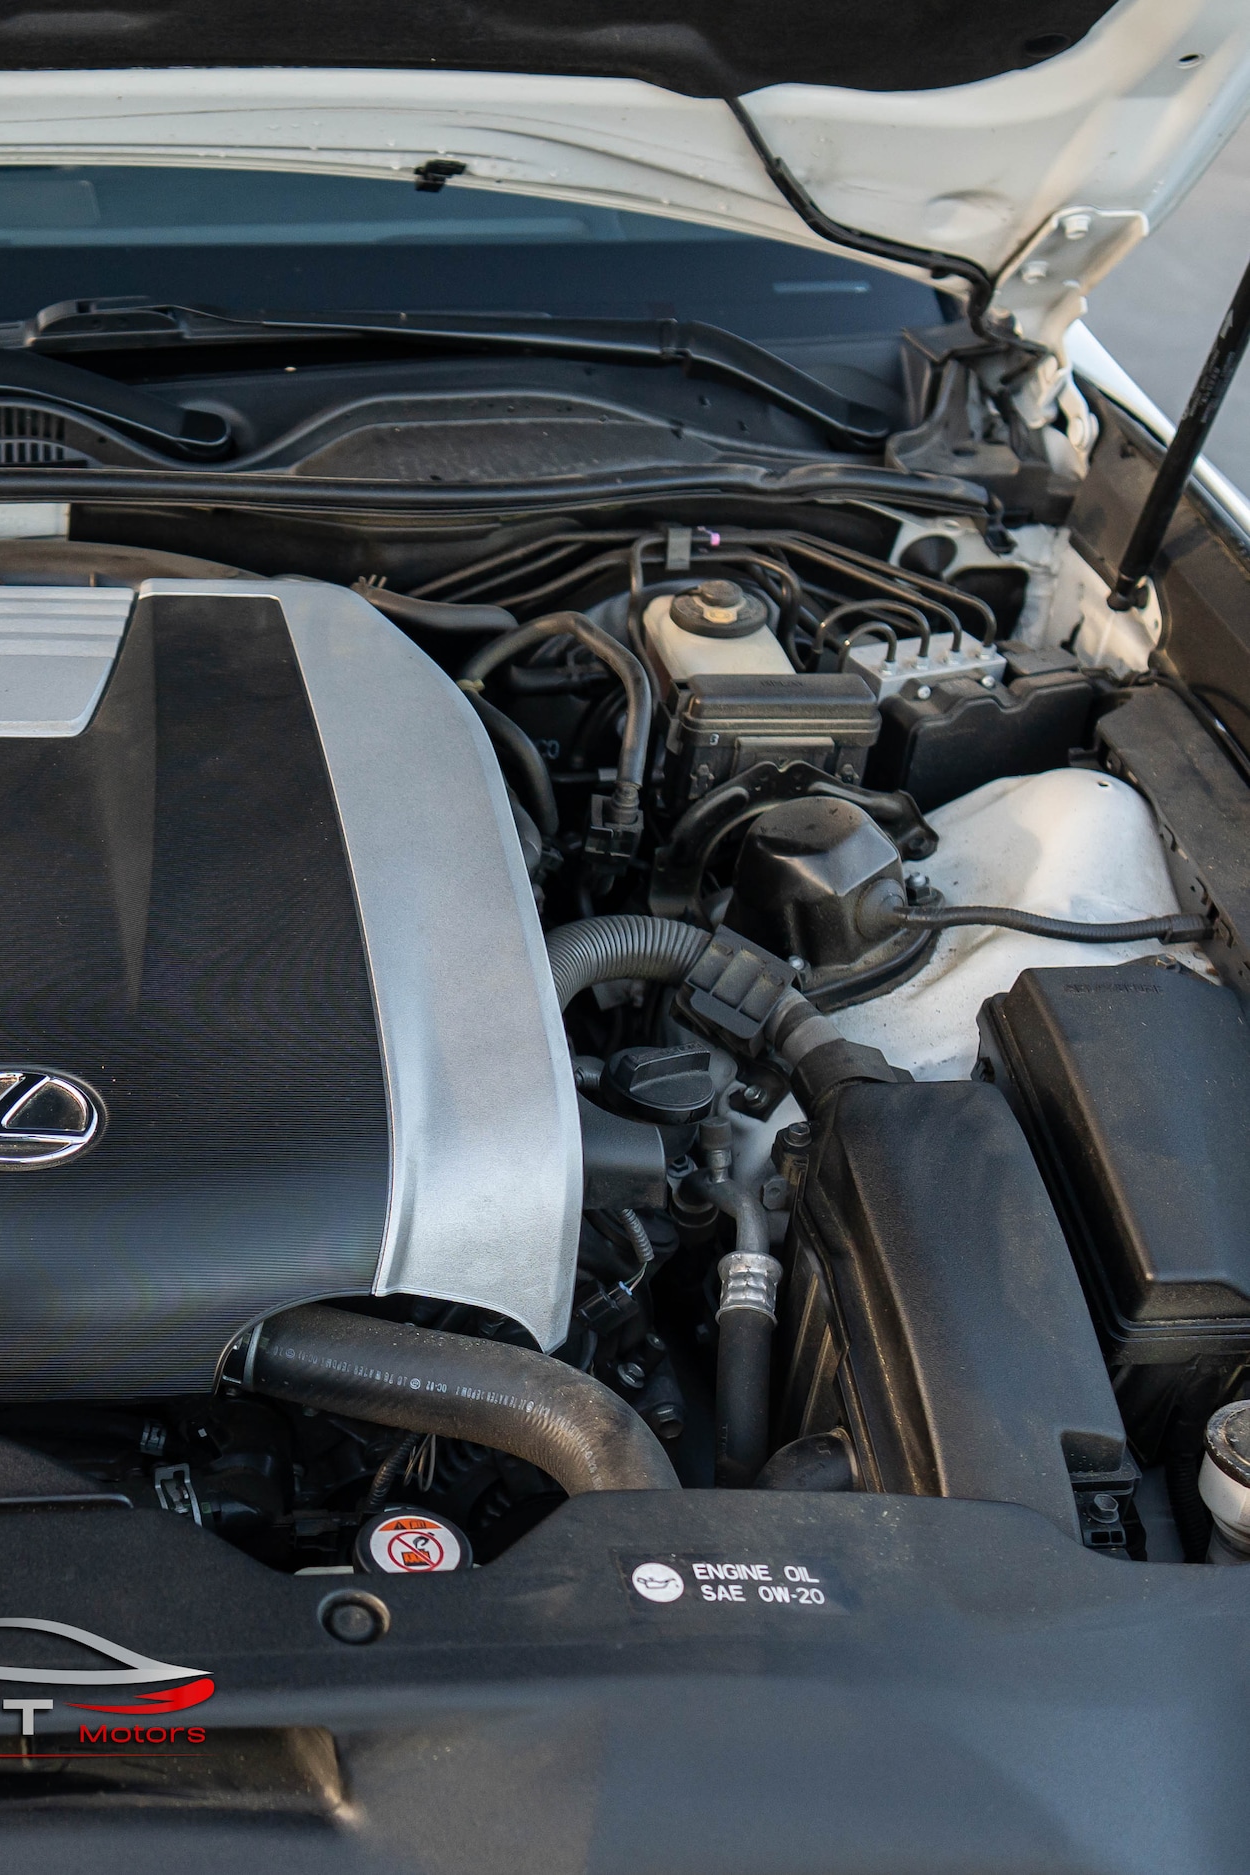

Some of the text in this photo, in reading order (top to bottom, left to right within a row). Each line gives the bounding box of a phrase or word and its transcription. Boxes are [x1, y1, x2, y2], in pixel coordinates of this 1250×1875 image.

[692, 1563, 820, 1583] ENGINE OIL
[700, 1584, 825, 1605] SAE 0W-20
